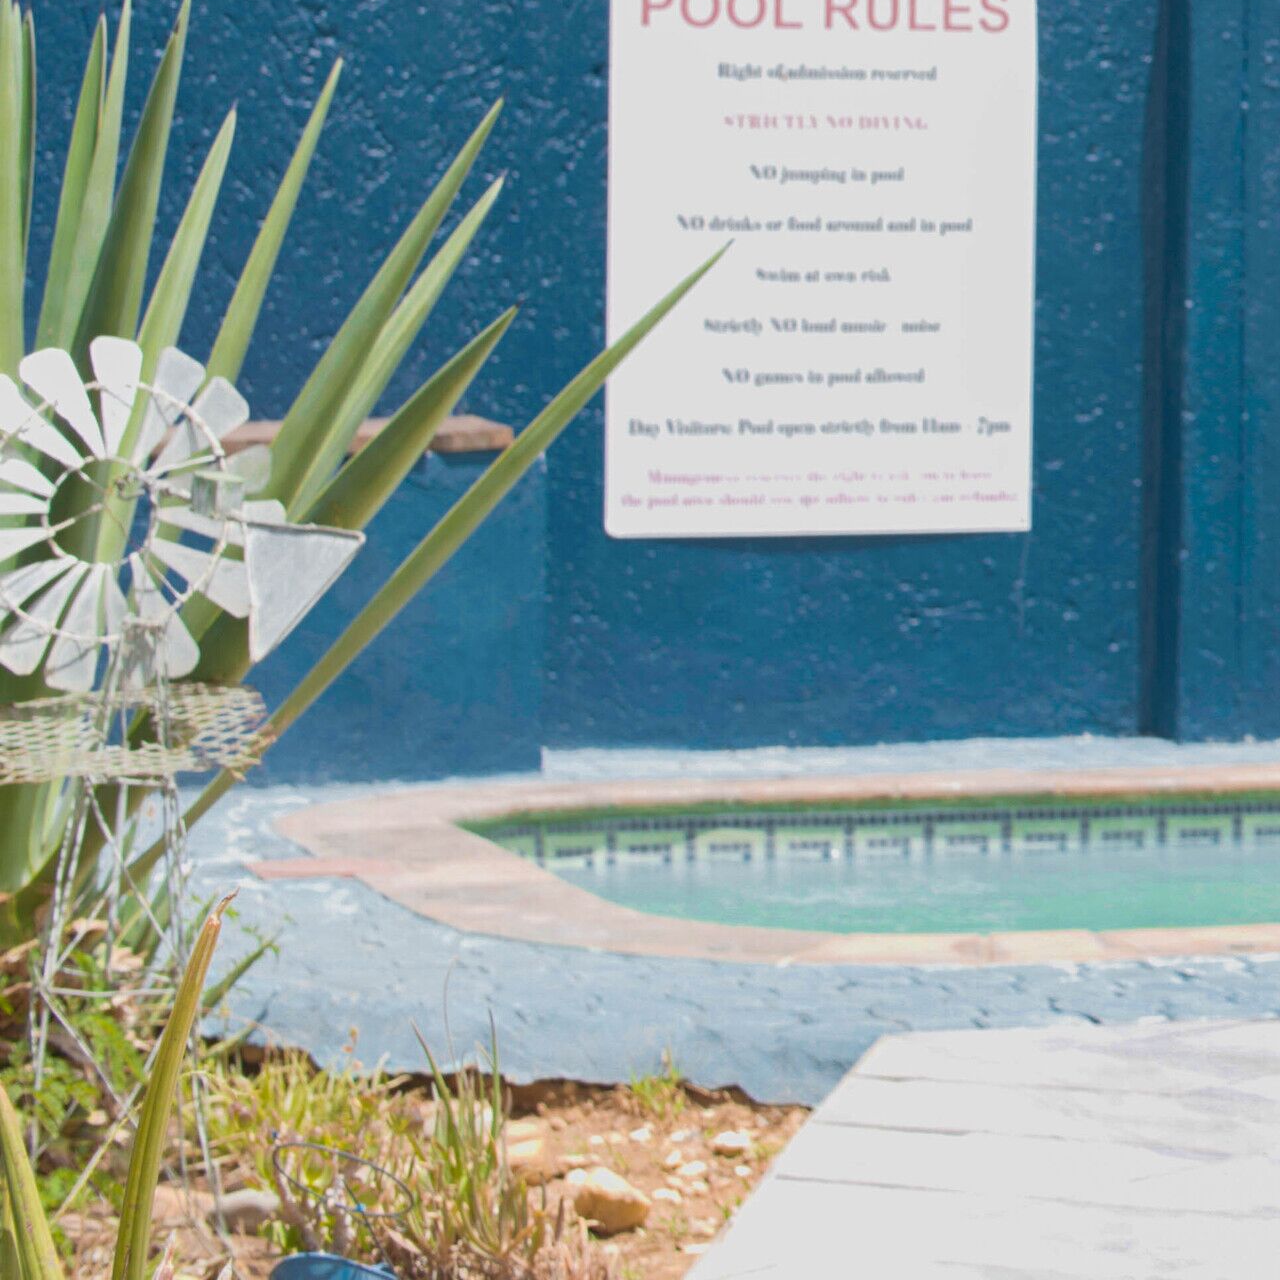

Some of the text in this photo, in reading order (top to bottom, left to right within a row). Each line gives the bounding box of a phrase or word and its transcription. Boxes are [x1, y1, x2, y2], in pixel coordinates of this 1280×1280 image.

[717, 62, 937, 81] Right of admission reserved
[724, 114, 929, 130] STRICTLY NO DIVING
[749, 164, 905, 185] NO jumping in pool
[676, 214, 973, 236] NO drinks or food around and in pool
[755, 267, 891, 283] Swim at own risk
[703, 318, 940, 335] Strictly NO loud music noise
[722, 368, 925, 387] NO games in pool allowed
[628, 418, 660, 437] Day
[738, 419, 774, 435] Pool
[777, 423, 817, 438] open
[820, 420, 874, 436] strictly
[879, 418, 918, 434] from
[977, 416, 1011, 436] 7pm
